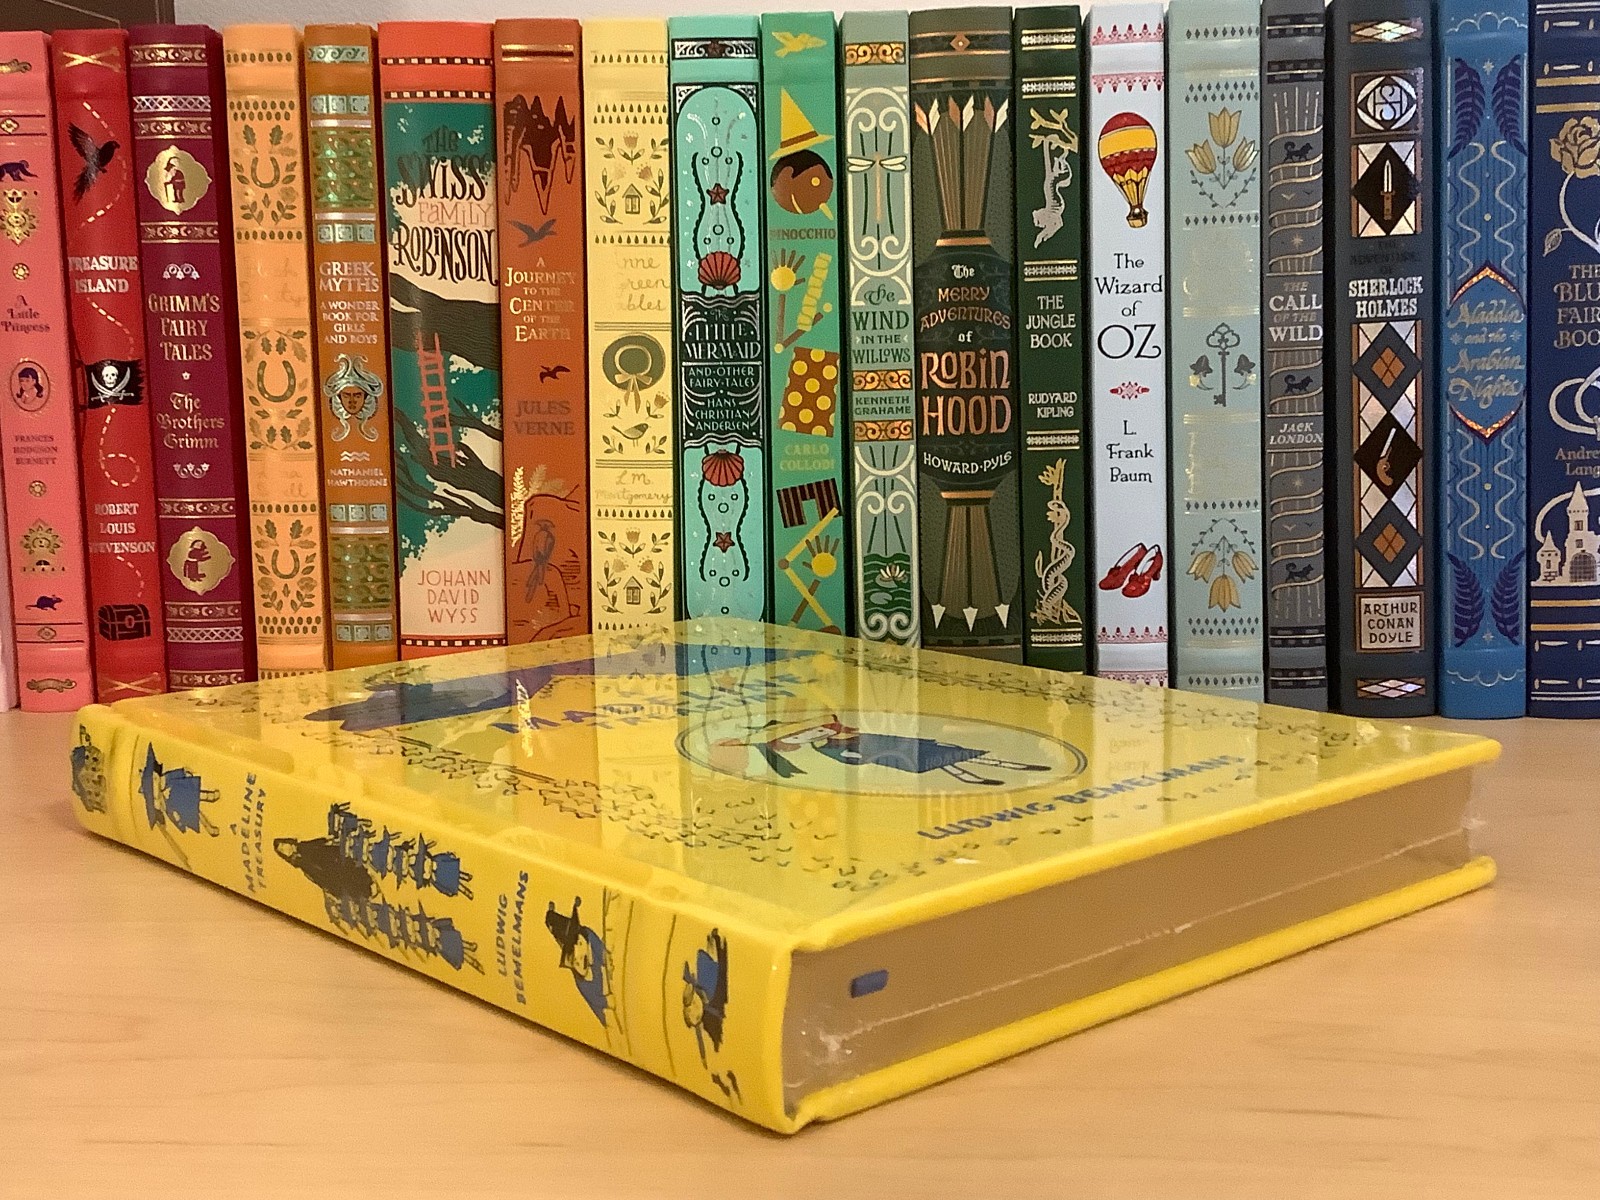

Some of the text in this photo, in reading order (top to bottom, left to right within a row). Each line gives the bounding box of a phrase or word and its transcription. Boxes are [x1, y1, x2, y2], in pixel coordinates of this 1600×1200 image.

[68, 255, 138, 272] TREASURE
[319, 261, 377, 277] GREEK
[536, 256, 546, 268] A
[1114, 252, 1145, 270] The
[504, 267, 576, 287] JOURNEY
[951, 264, 975, 280] The
[75, 278, 129, 293] ISLAND
[320, 277, 380, 293] MYTHS
[522, 286, 538, 296] TO
[1094, 275, 1163, 296] Wizard
[1283, 281, 1309, 292] THE
[1348, 276, 1424, 298] SHERLOCK
[1553, 282, 1600, 302] BLU
[328, 301, 381, 311] WONDER
[509, 297, 575, 315] CENTER
[1037, 295, 1065, 311] THE
[1121, 300, 1143, 318] of
[1268, 293, 1323, 312] CALL
[1355, 298, 1418, 318] HOLMES
[323, 312, 379, 322] BOOK FOR
[523, 315, 537, 324] OF
[851, 310, 910, 331] WIND
[1026, 313, 1077, 330] JUNGLE
[1273, 311, 1317, 323] OF THE
[1447, 299, 1526, 329] Aladdin
[1557, 306, 1600, 325] FAIR
[161, 317, 208, 337] FAIRY
[333, 323, 366, 333] GIRLS
[514, 325, 571, 342] EARTH
[1268, 324, 1324, 343] WILD
[1464, 327, 1488, 344] and
[325, 334, 378, 344] AND BOYS
[861, 334, 901, 345] IN THE
[957, 330, 974, 343] of
[1030, 332, 1073, 349] BOOK
[1097, 323, 1162, 360] OZ
[1554, 329, 1600, 349] BOO
[160, 342, 213, 361] TALES
[685, 341, 762, 360] MERMAID
[852, 347, 912, 364] WILLOWS
[1447, 346, 1526, 374] Arabian
[169, 392, 201, 413] The
[706, 398, 736, 408] HANS
[855, 395, 910, 406] KENNETH
[1028, 391, 1078, 404] RUDYARD
[516, 400, 572, 417] JULES
[694, 409, 750, 421] CHRISTIAN
[854, 405, 912, 416] GRAHAME
[921, 394, 1012, 436] HOOD
[1036, 406, 1075, 419] KIPLING
[156, 413, 225, 433] Brothers
[515, 421, 576, 436] VERNE
[695, 421, 750, 431] ANDERSEN
[1122, 419, 1138, 437] L.
[1279, 422, 1314, 433] JACK
[163, 433, 219, 449] Grimm
[1269, 433, 1324, 445] LONDON
[1106, 443, 1155, 460] Frank
[1554, 445, 1600, 461] Andre
[330, 468, 384, 476] NATHANIEL
[923, 452, 979, 475] HOWARD
[327, 479, 388, 487] HAWTHORNE
[1109, 466, 1153, 484] Baum
[95, 503, 139, 515] ROBERT
[100, 523, 136, 534] LOUIS
[417, 569, 492, 587] JOHANN
[427, 588, 480, 606] DAVID
[428, 608, 479, 624] WYSS
[1363, 602, 1418, 617] ARTHUR
[1367, 617, 1414, 630] CONAN
[1369, 631, 1414, 644] DOYLE
[919, 802, 1056, 841] LUDWIG
[240, 771, 258, 893] MADELINE
[254, 788, 267, 889] TREASURY
[495, 893, 509, 978] LUDWIG
[511, 869, 530, 1006] BEMELMANS
